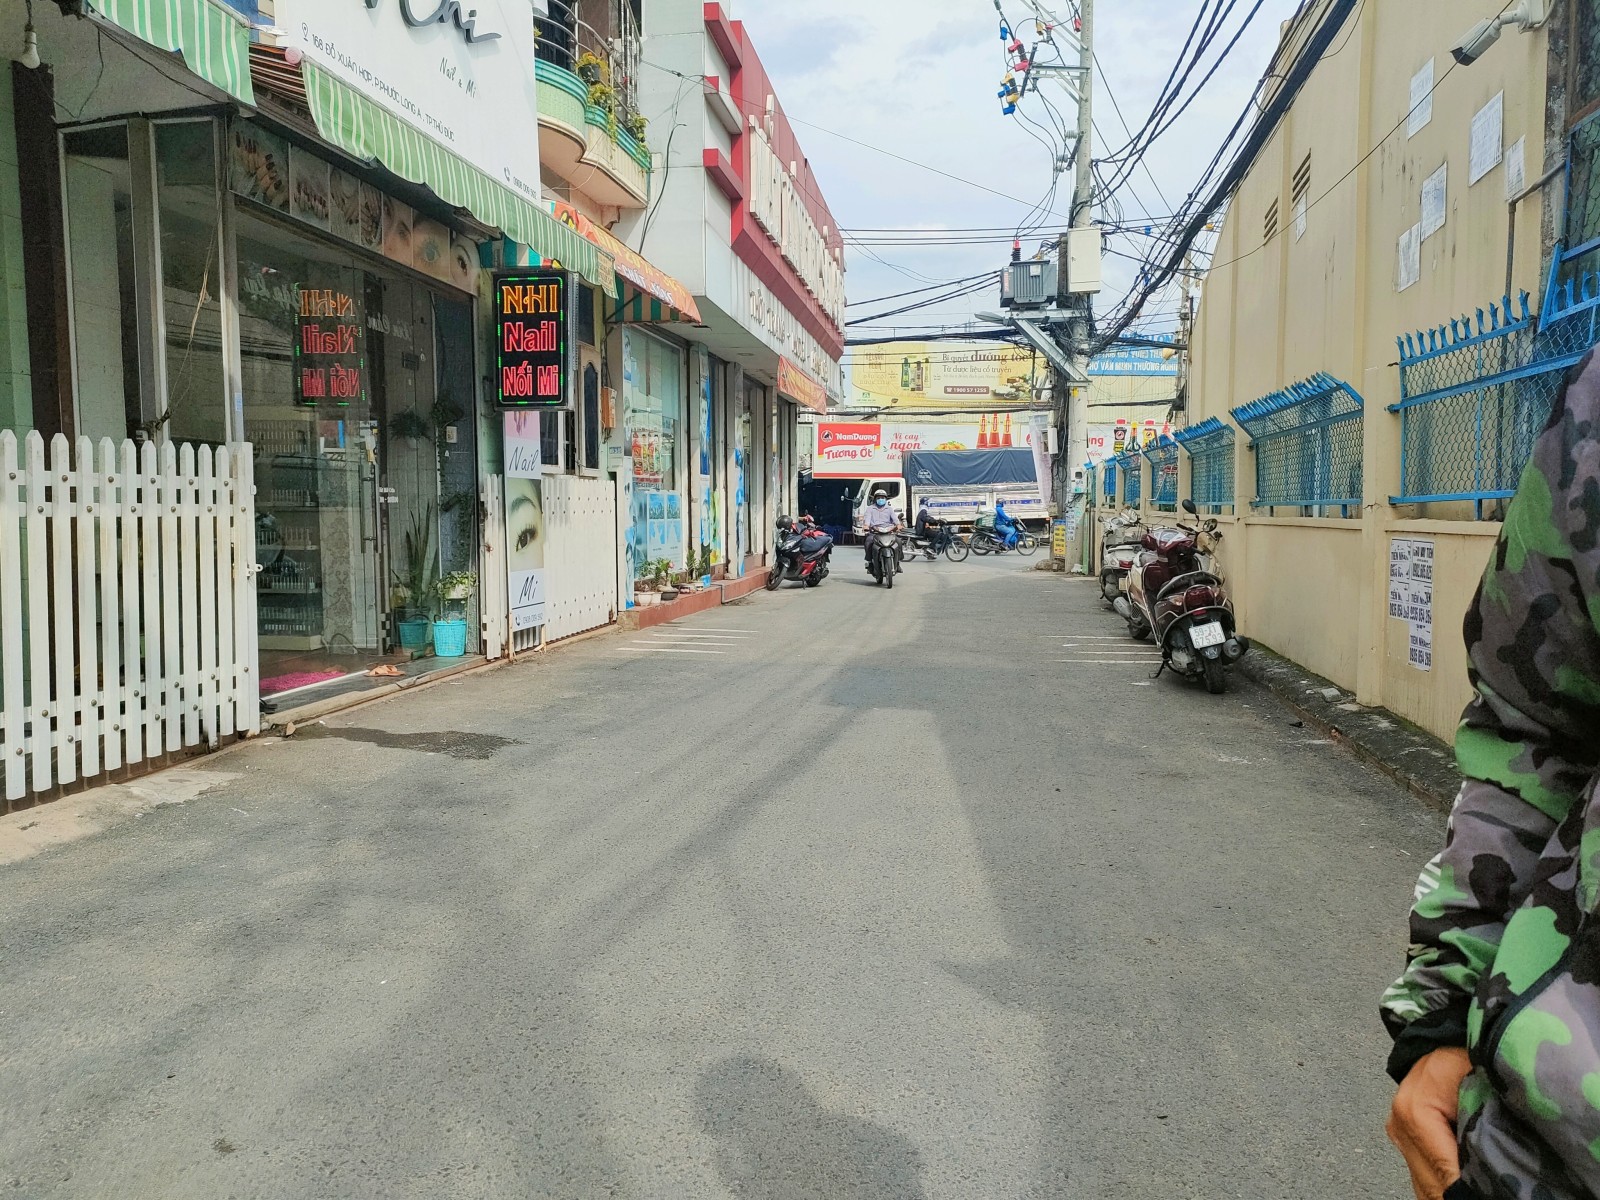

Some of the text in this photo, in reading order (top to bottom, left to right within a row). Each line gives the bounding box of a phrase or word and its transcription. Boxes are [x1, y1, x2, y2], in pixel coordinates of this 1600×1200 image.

[439, 56, 457, 82] Nail
[465, 79, 477, 98] Mi
[502, 284, 559, 314] NHI
[504, 320, 557, 352] Nail
[942, 364, 952, 373] Từ
[969, 364, 982, 375] liệu
[991, 365, 1012, 376] truyền
[970, 350, 1008, 366] dưỡng
[503, 360, 559, 397] Nối Mi
[825, 446, 873, 460] Tương Ớt
[889, 442, 921, 453] ngon
[1088, 437, 1104, 447] ng
[509, 446, 539, 472] Nail
[518, 574, 538, 604] Mi
